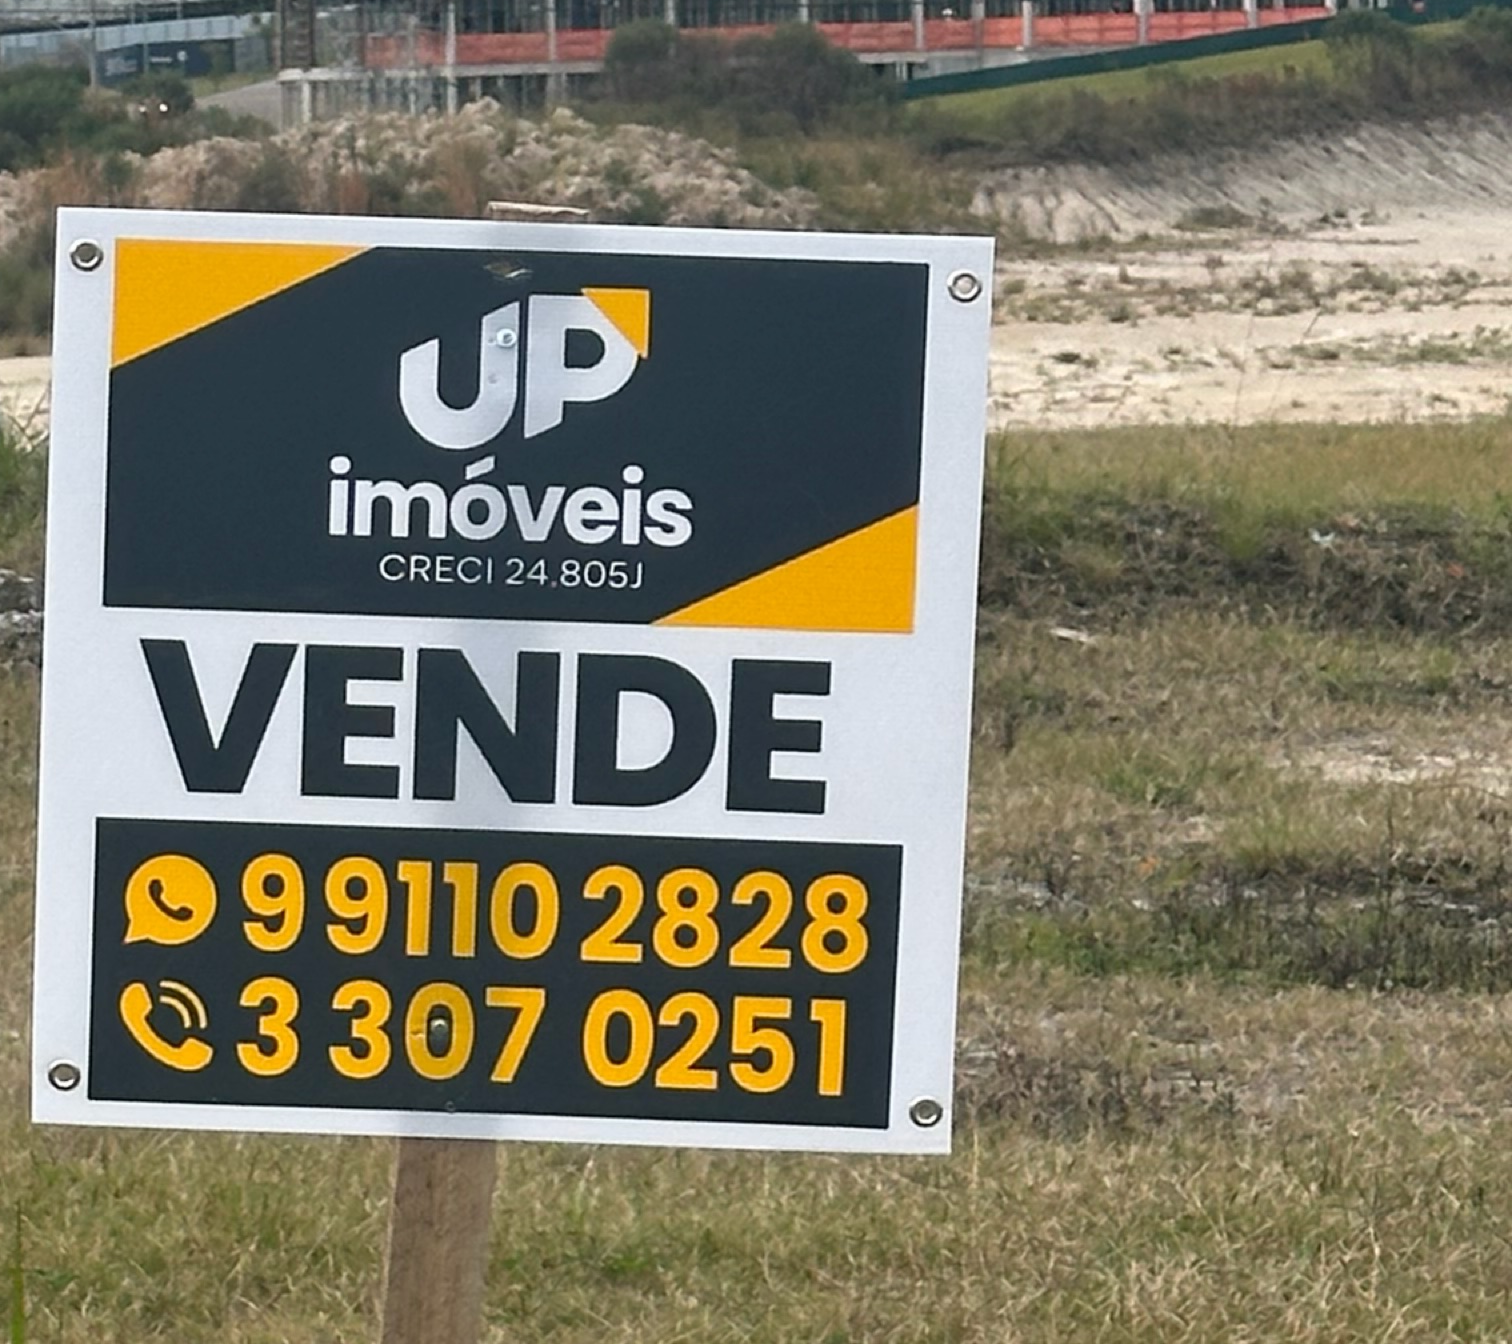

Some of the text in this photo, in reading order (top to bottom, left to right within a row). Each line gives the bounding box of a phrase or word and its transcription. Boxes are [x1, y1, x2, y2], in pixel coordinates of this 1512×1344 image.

[328, 455, 694, 548] imóveis
[378, 554, 645, 590] CRECI 24.805J
[138, 637, 833, 815] VENDE
[579, 864, 870, 975] 2828
[582, 987, 848, 1097] 0251
